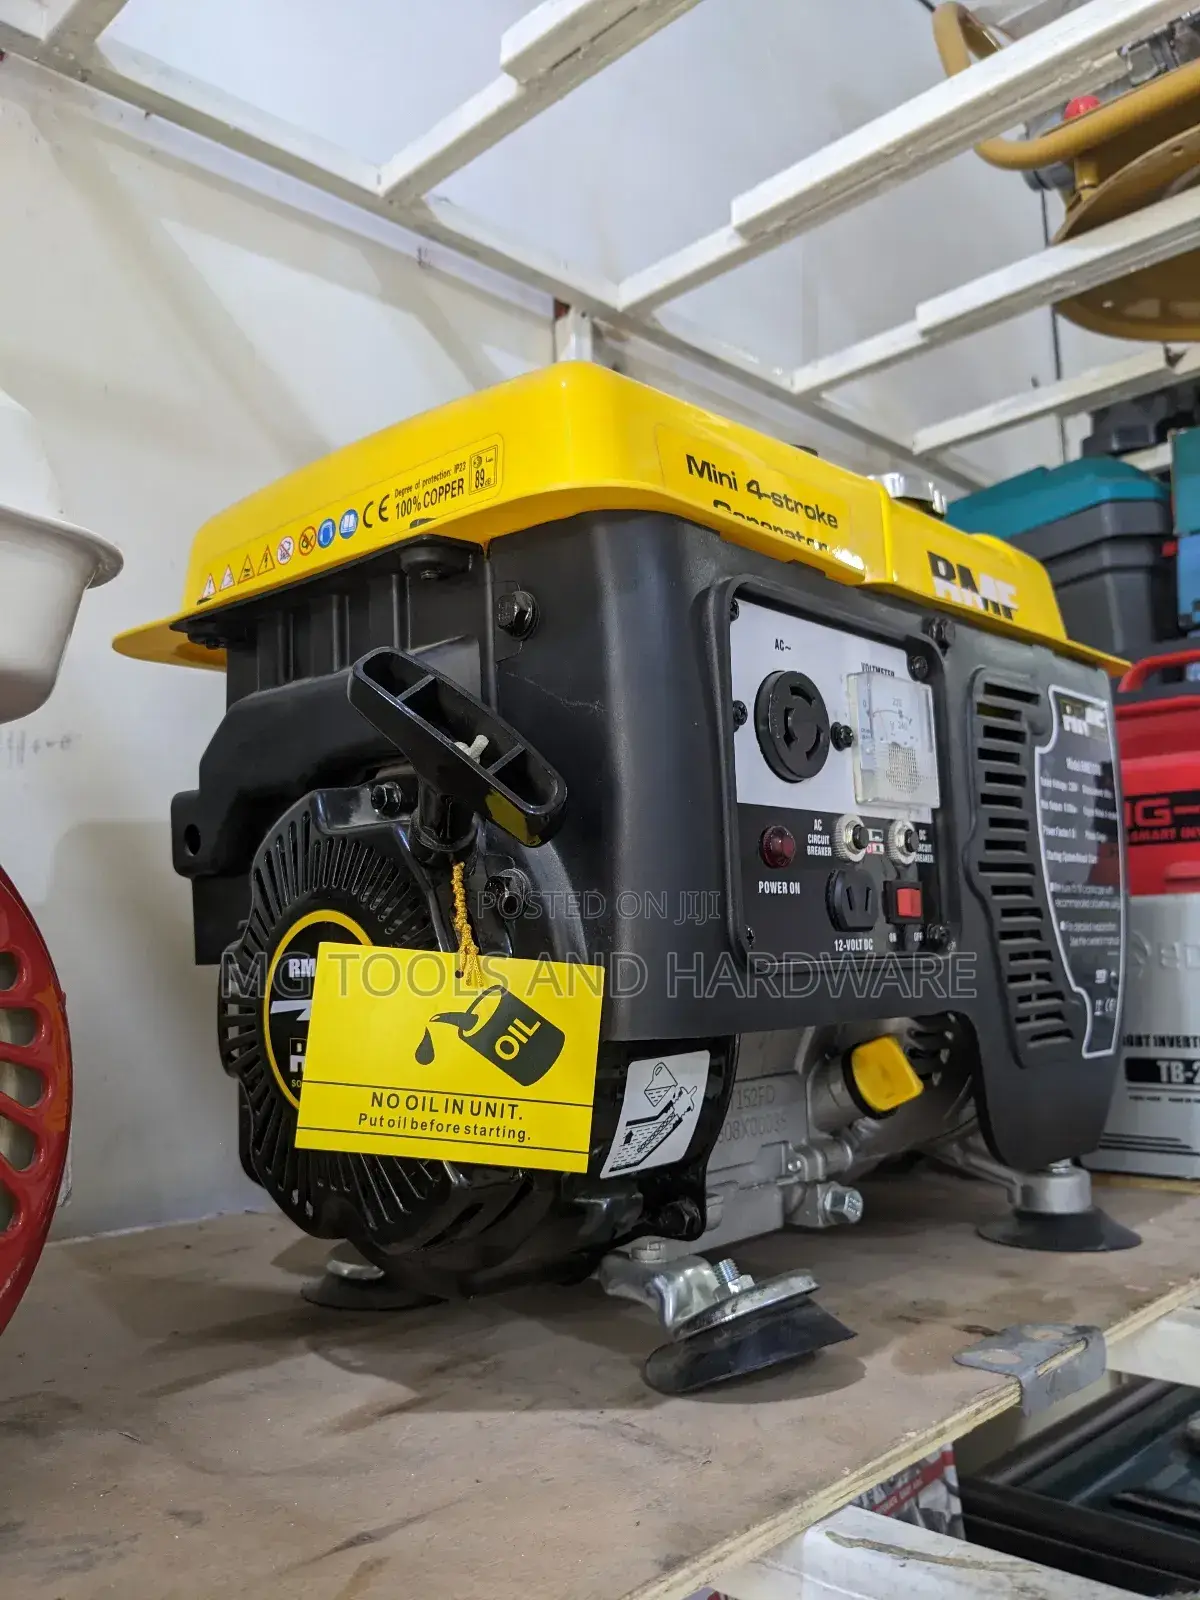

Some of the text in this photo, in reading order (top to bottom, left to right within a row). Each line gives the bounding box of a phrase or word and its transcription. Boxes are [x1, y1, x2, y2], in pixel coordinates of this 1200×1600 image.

[395, 485, 413, 499] Degree
[422, 468, 452, 488] protection:
[454, 461, 467, 474] IP23
[474, 468, 485, 489] 89
[396, 478, 464, 519] 100% COPPER
[686, 454, 738, 492] Mini
[746, 479, 838, 529] 4-stroke
[861, 661, 895, 678] VOLTMETER
[813, 819, 823, 831] AC
[807, 834, 830, 845] CIRCUIT
[807, 846, 832, 856] BREAKER
[758, 880, 801, 895] POWER ON
[834, 938, 873, 952] 12-VOLT DC
[288, 958, 317, 978] RM
[494, 1017, 542, 1061] OIL
[371, 1091, 523, 1120] NO OIL IN UNIT.
[358, 1113, 531, 1143] Put oil before starting.
